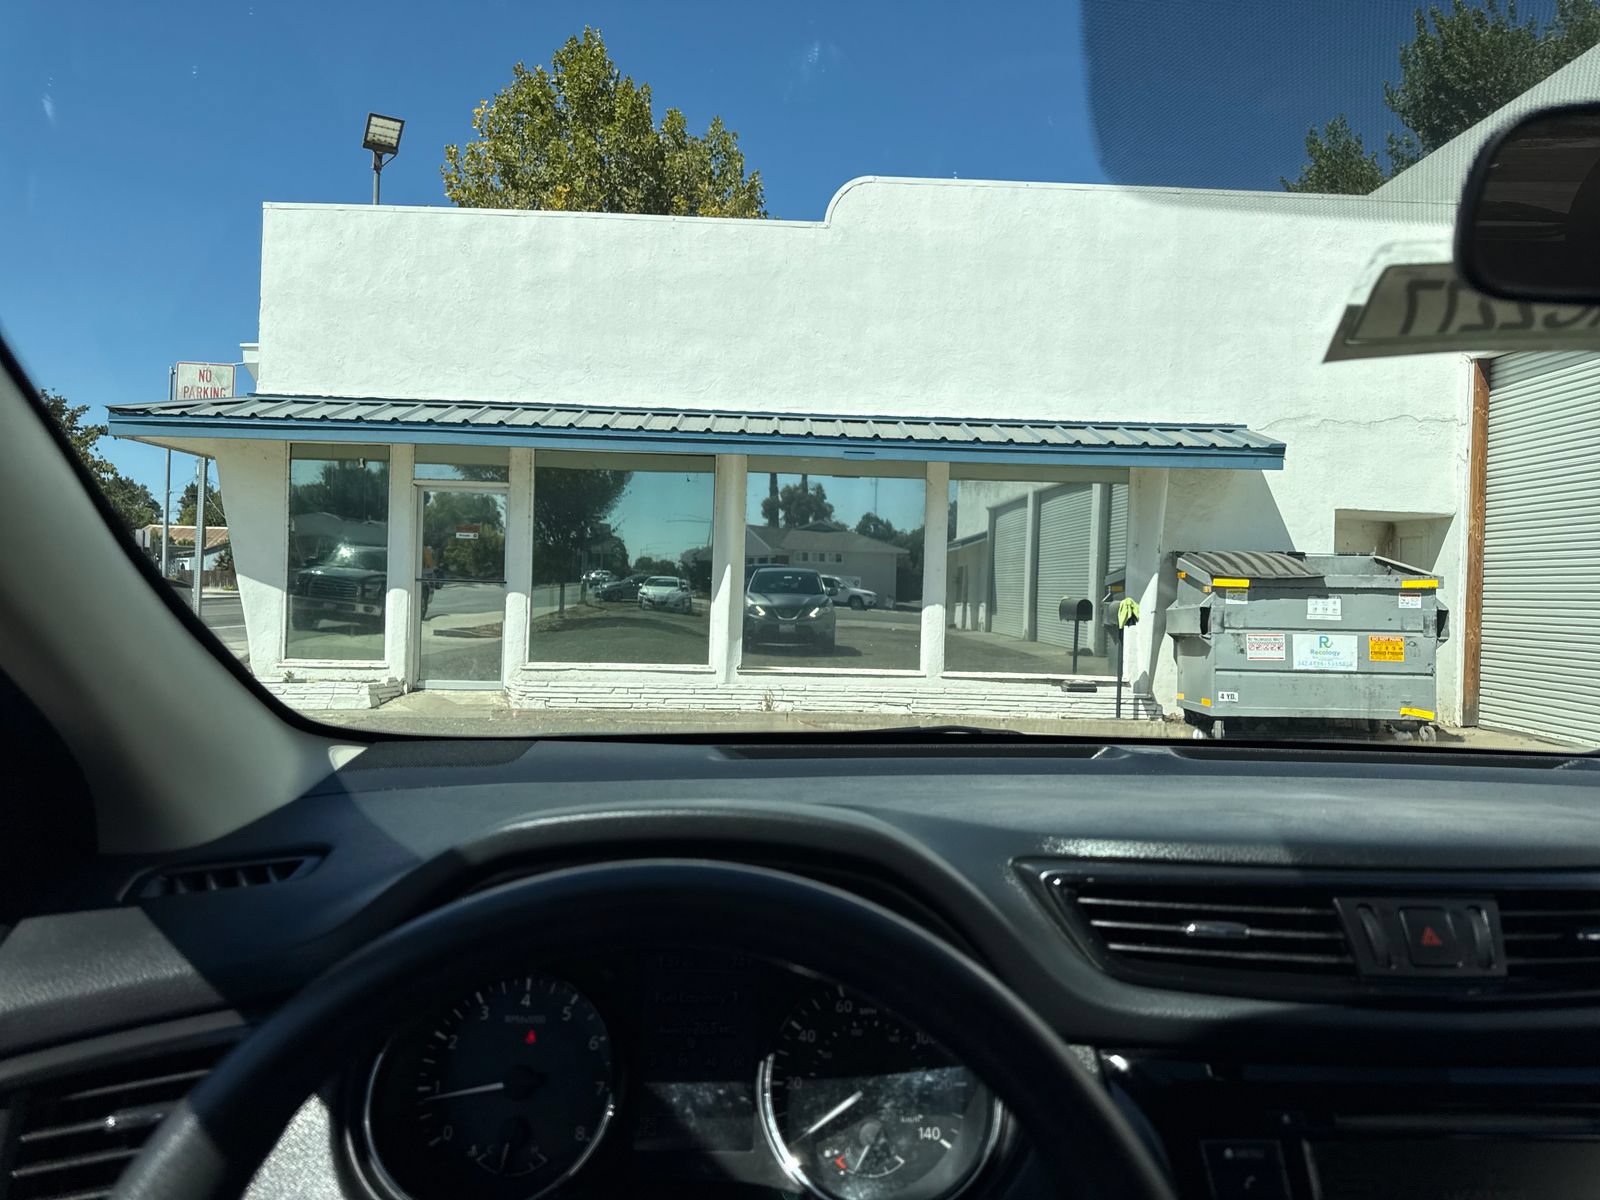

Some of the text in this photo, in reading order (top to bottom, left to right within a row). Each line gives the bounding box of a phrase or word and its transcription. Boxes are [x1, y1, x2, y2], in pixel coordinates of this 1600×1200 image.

[198, 368, 212, 383] NO
[183, 385, 226, 399] PARKING
[1310, 648, 1341, 657] Recology
[519, 993, 531, 1008] 4
[835, 1000, 853, 1014] 60
[479, 1005, 489, 1021] 3
[562, 1006, 572, 1021] 5
[447, 1034, 459, 1050] 2
[588, 1035, 598, 1051] 6
[798, 1029, 816, 1043] 40
[919, 1126, 941, 1141] 140
